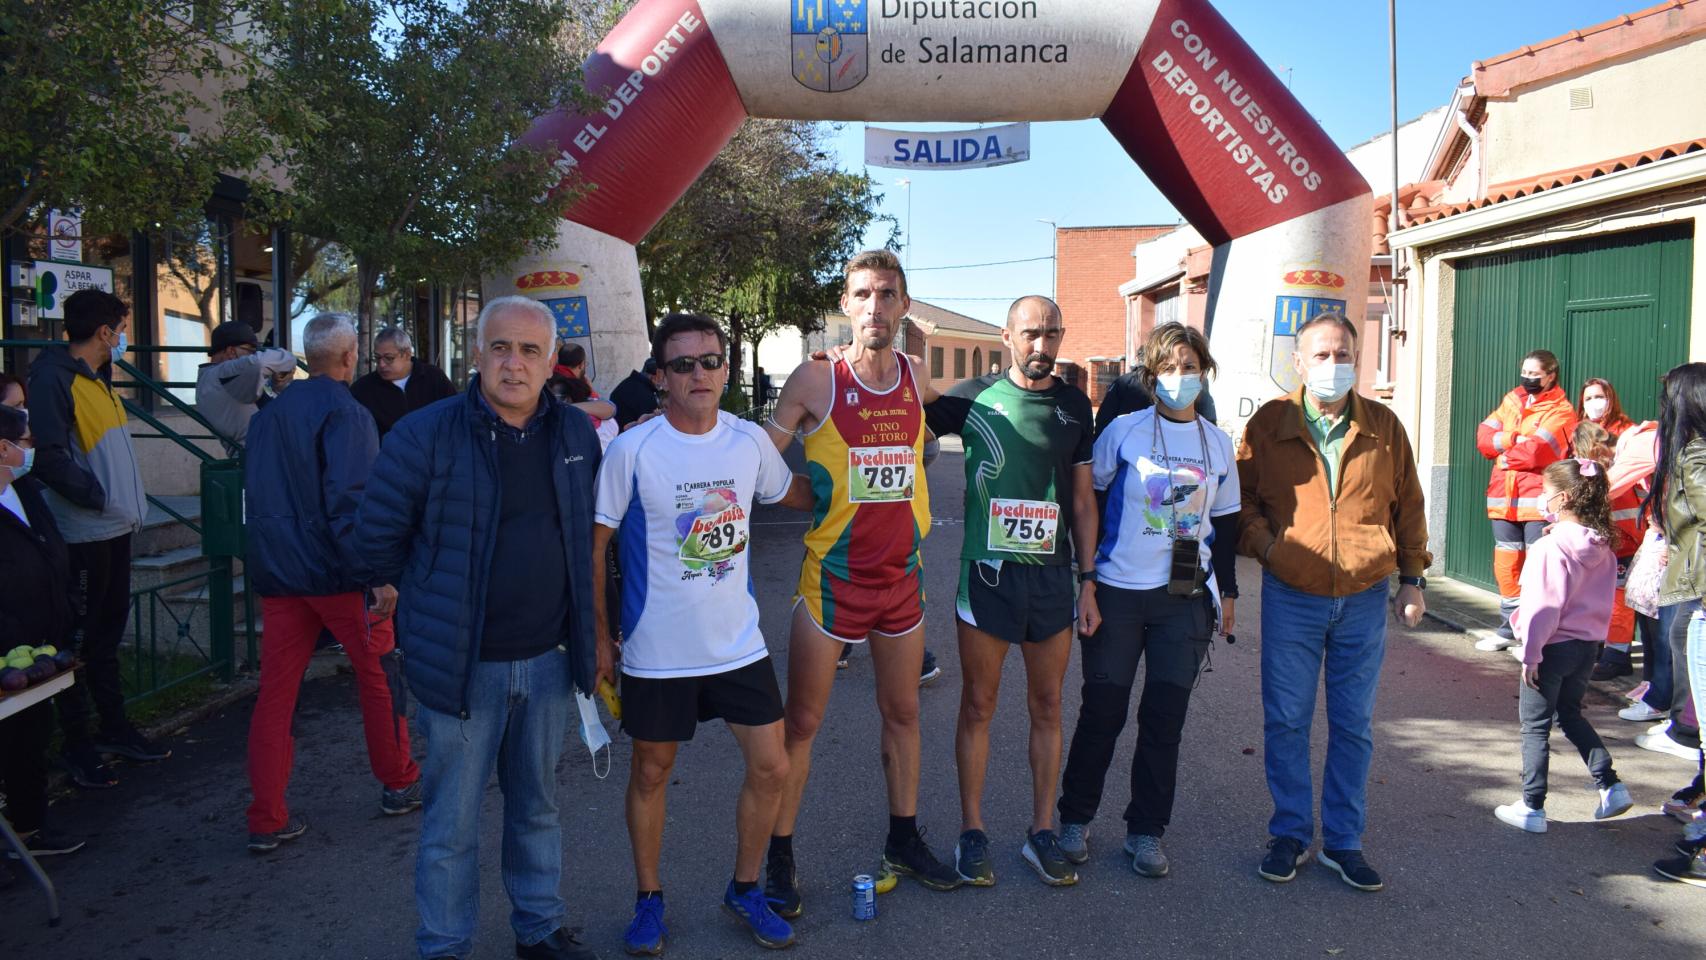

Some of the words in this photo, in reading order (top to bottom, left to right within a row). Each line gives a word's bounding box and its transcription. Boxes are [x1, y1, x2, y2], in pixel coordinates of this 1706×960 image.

[881, 43, 906, 63] de
[918, 36, 1068, 64] Salamanca
[573, 122, 608, 153] EL
[602, 10, 702, 120] DEPORTE
[1170, 18, 1219, 71] CON
[1214, 69, 1322, 192] NUESTROS
[1151, 50, 1289, 204] DEPORTISTAS
[894, 135, 1002, 163] SALIDA
[65, 270, 91, 280] ASPAR
[862, 434, 877, 443] DE
[880, 432, 908, 441] TORO
[872, 422, 900, 431] VINO
[850, 450, 915, 467] bedunia
[864, 466, 906, 489] 787
[991, 502, 1057, 520] bedunia
[700, 523, 735, 552] 789
[1003, 518, 1046, 541] 756
